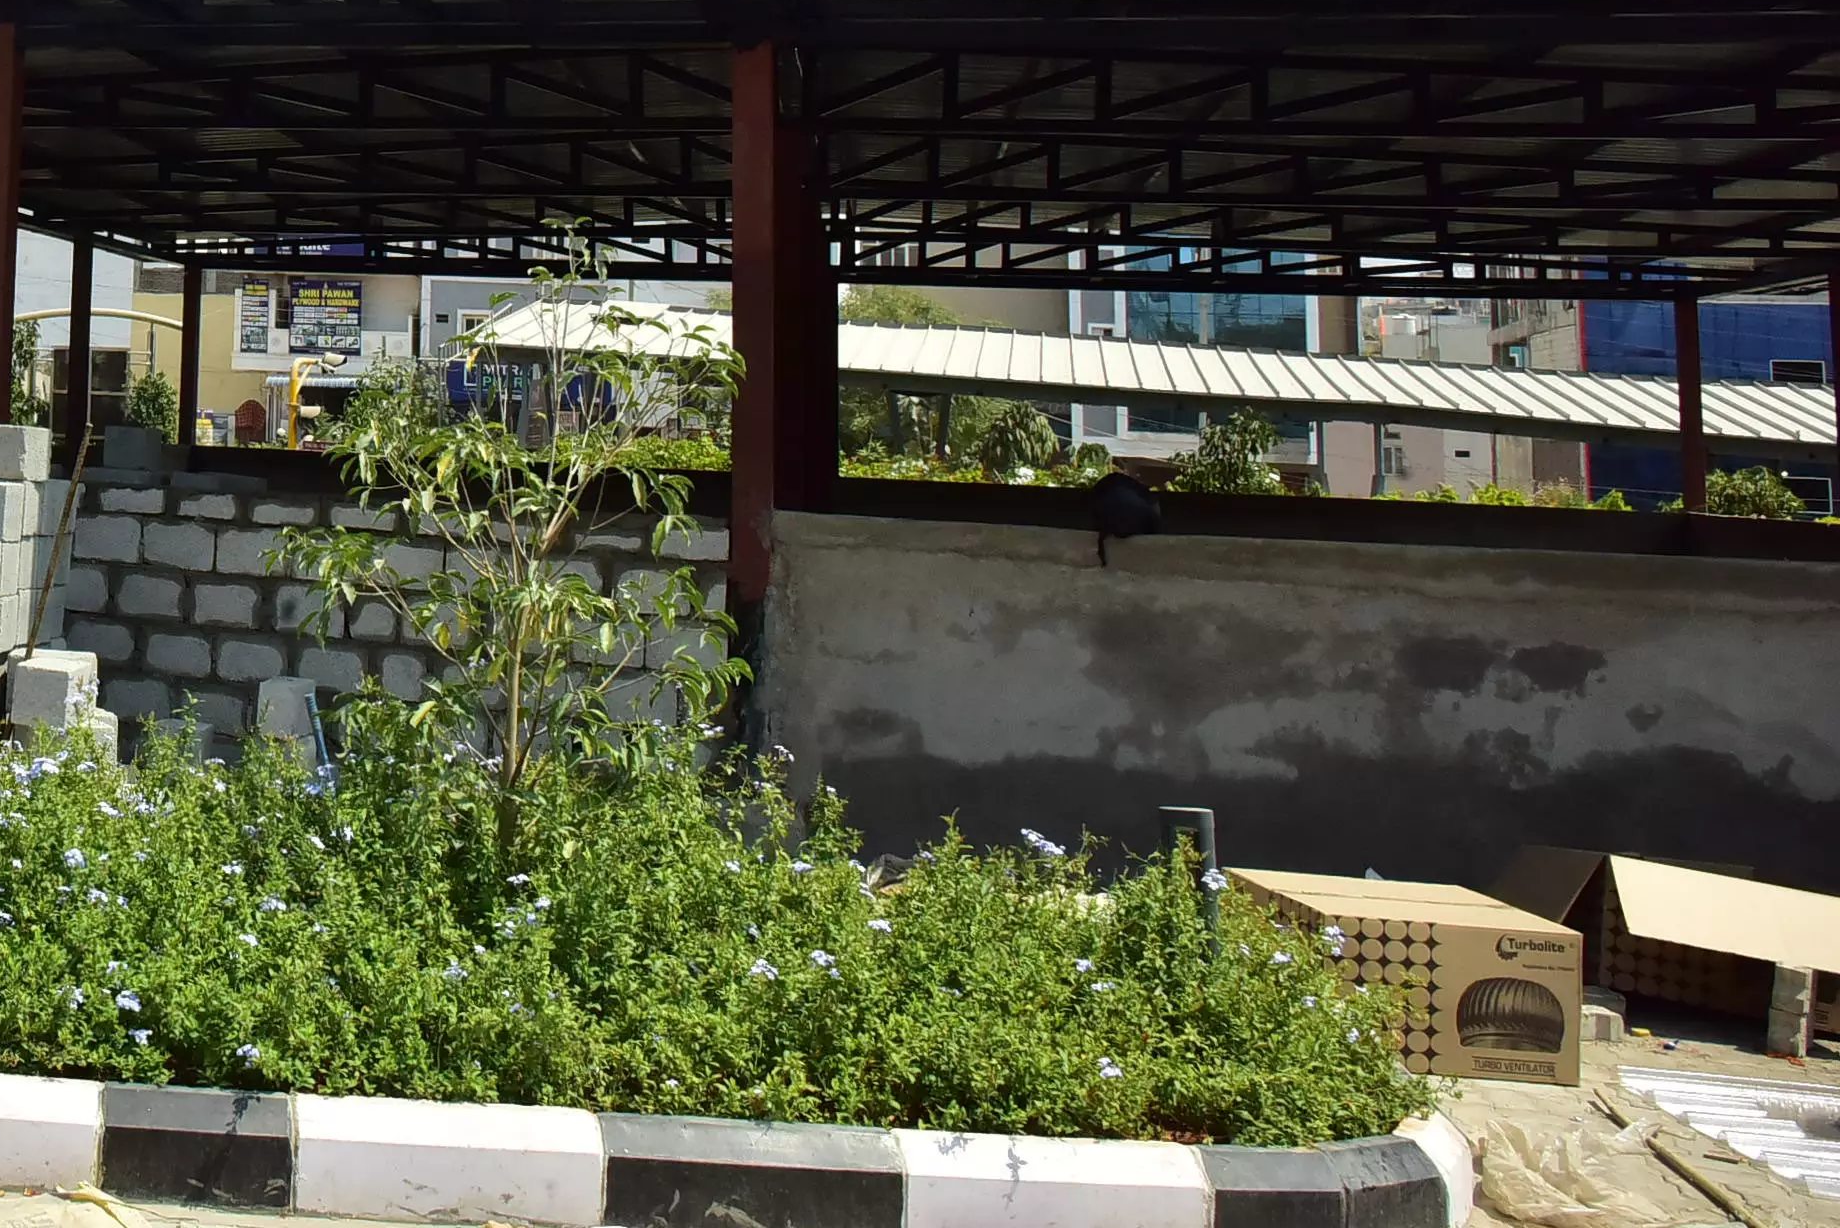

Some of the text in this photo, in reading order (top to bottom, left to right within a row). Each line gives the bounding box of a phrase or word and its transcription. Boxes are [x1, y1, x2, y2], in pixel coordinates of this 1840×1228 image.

[298, 288, 354, 299] SHRI PAWAN
[1507, 937, 1566, 953] Turbolite
[1473, 1059, 1556, 1075] TURBO VENTILATOR
